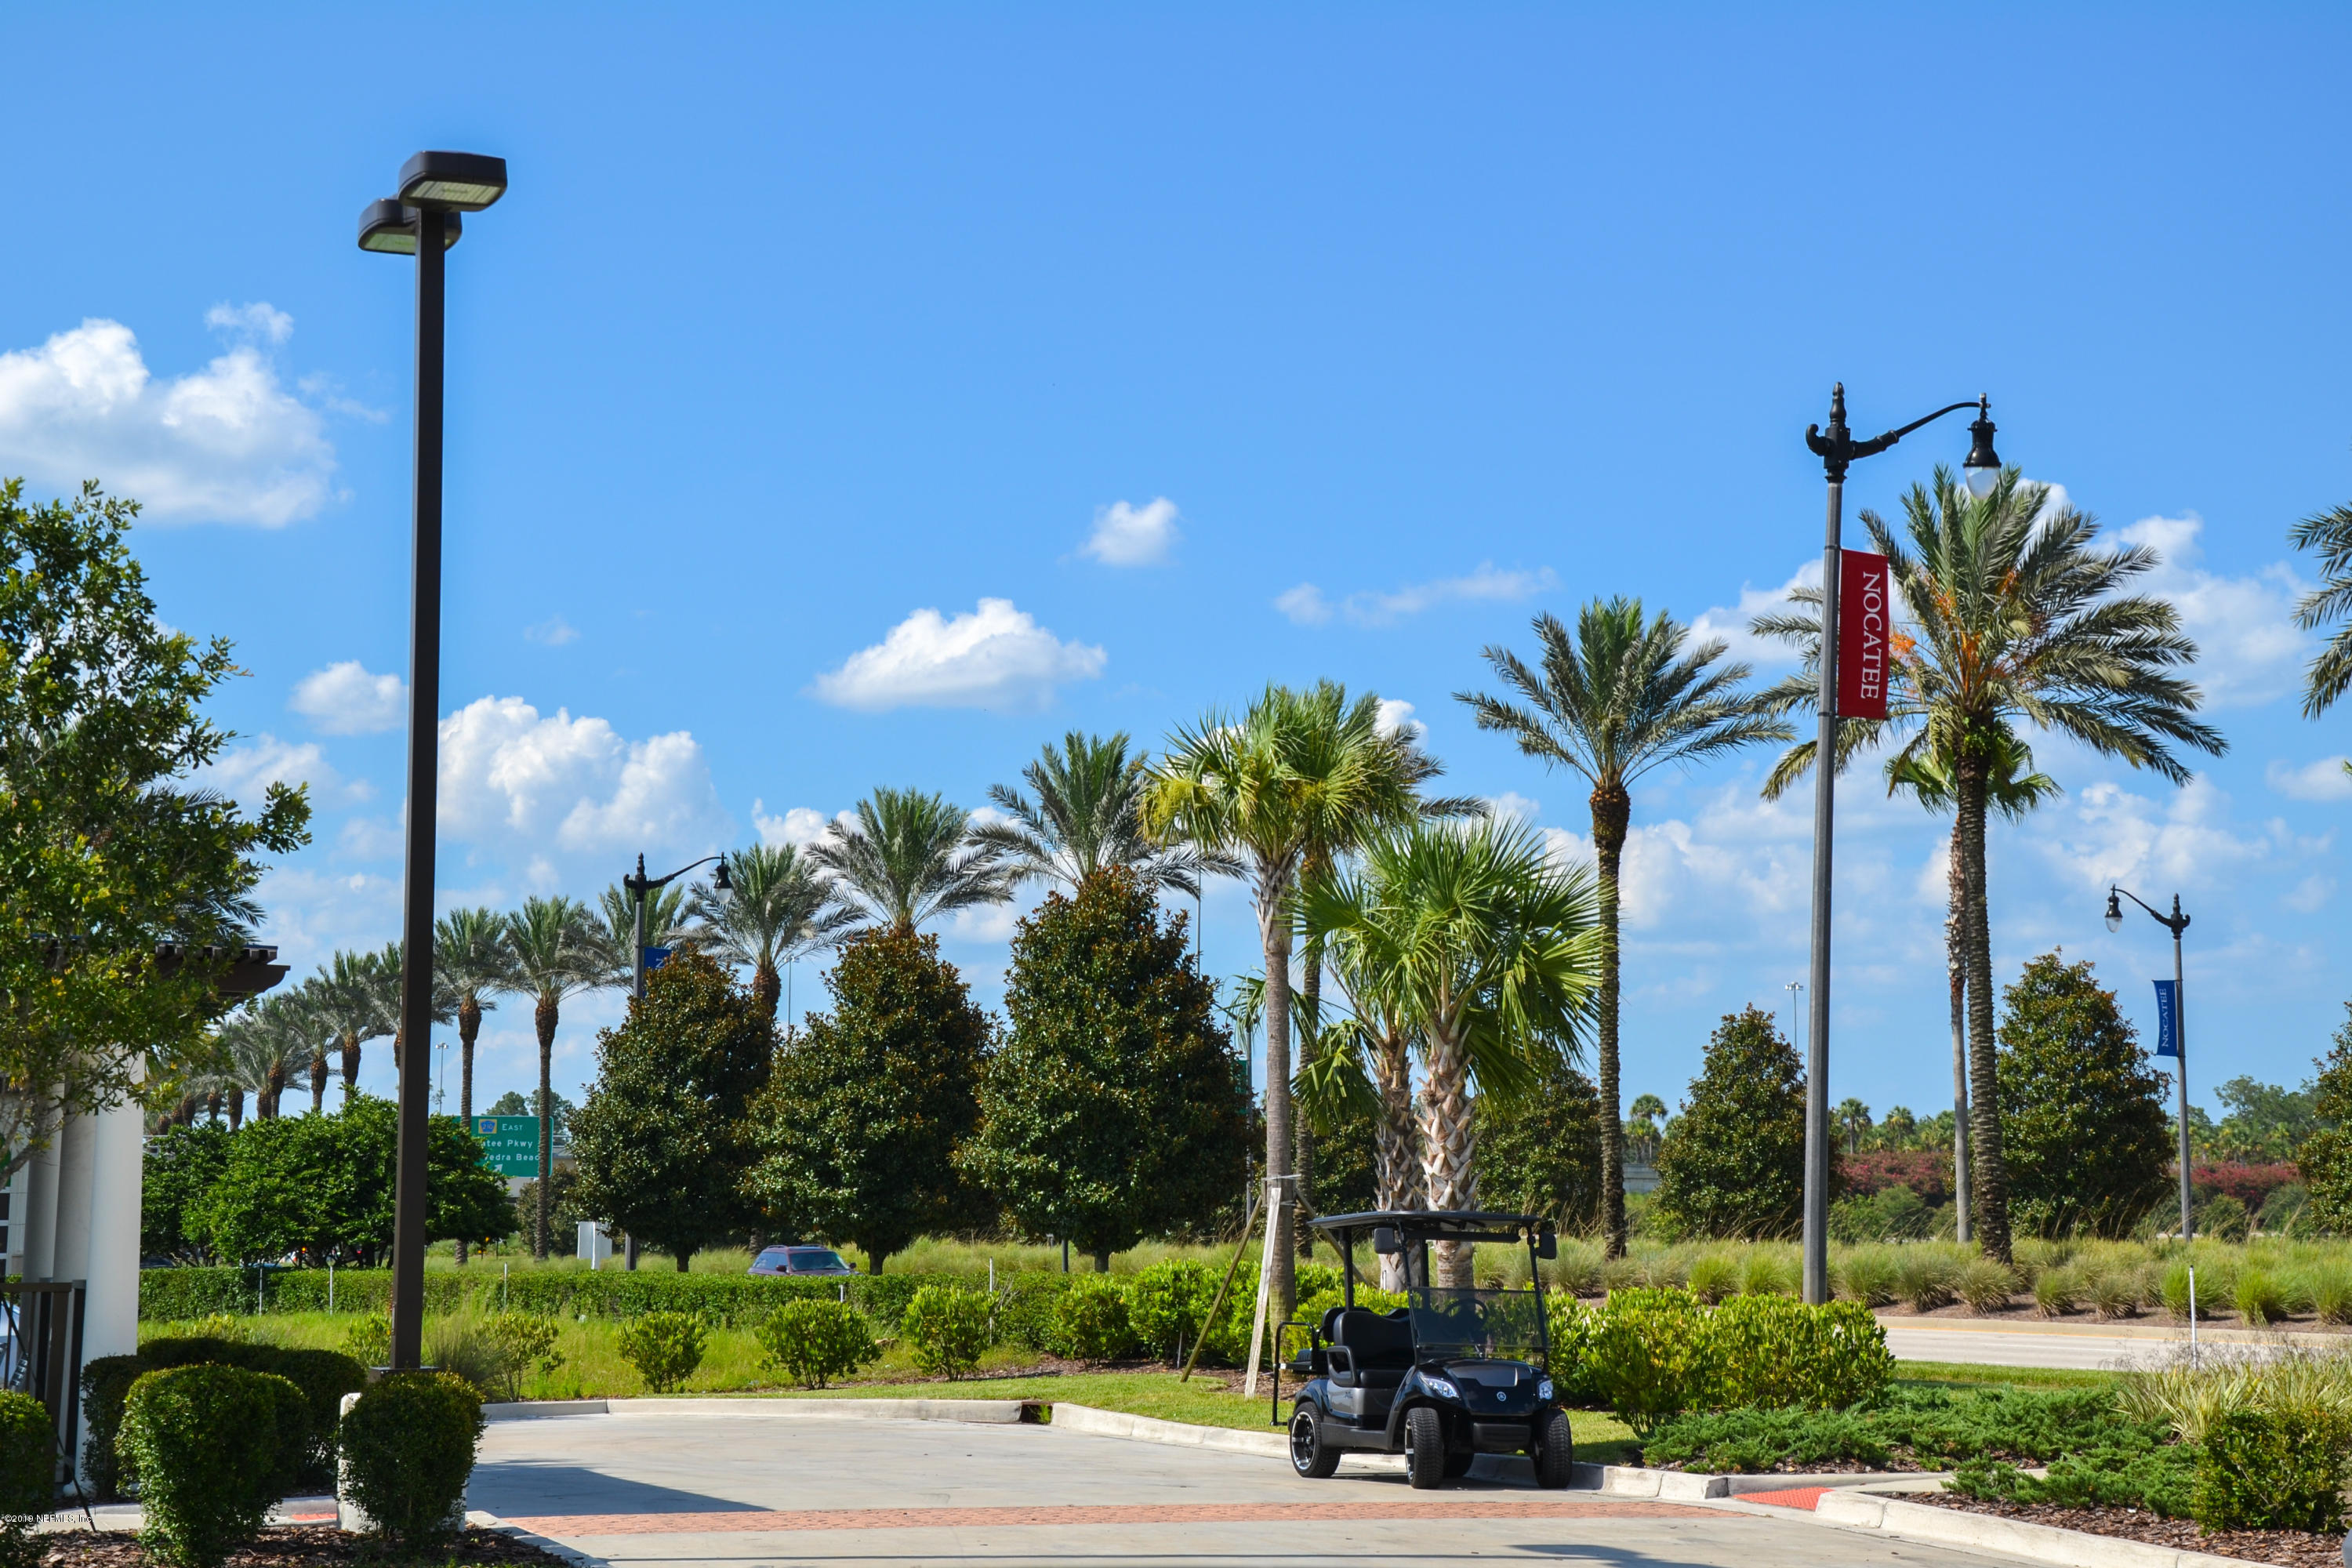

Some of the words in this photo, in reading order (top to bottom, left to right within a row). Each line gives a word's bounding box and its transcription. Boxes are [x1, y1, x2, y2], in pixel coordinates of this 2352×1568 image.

[1860, 571, 1882, 699] NOCATEE
[2159, 988, 2169, 1047] NOCATEE
[507, 1139, 533, 1149] Pkwy
